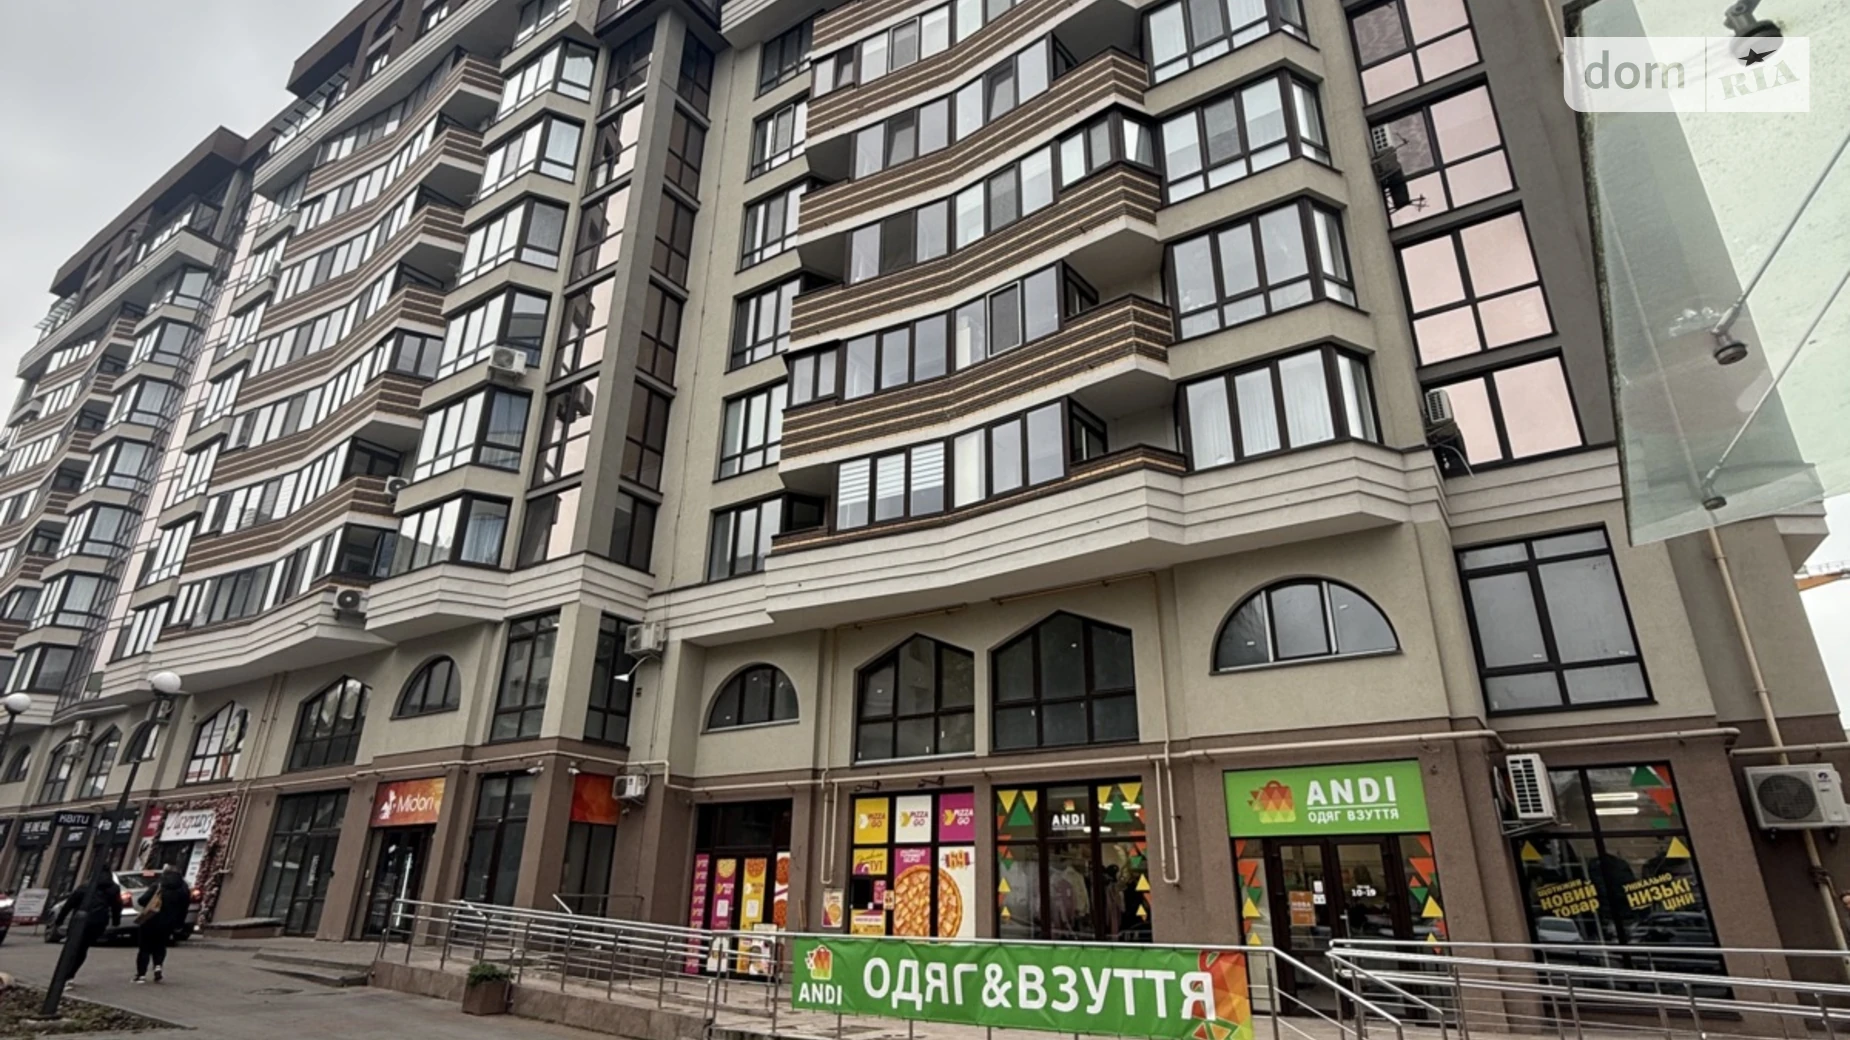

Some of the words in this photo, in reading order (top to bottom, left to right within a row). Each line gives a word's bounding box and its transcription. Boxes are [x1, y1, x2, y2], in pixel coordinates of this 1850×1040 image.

[1307, 776, 1397, 806] ANDI
[396, 792, 436, 812] Midori
[868, 811, 886, 820] PIZZA
[910, 811, 929, 819] PIZZA
[953, 808, 975, 817] PIZZA
[1052, 813, 1085, 826] ANDI
[1308, 810, 1342, 824] ОДЯГ
[1347, 808, 1399, 822] ВЗУТТЯ
[871, 819, 883, 828] GO
[913, 819, 926, 827] GO
[957, 817, 971, 826] GO
[1540, 880, 1599, 911] НОВИЙ
[1626, 878, 1691, 908] НИЗЬКІ
[1662, 893, 1696, 911] ЦІНИ
[798, 982, 842, 1006] ANDI
[863, 957, 1217, 1021] ОДЯГ&ВЗУТТЯ
